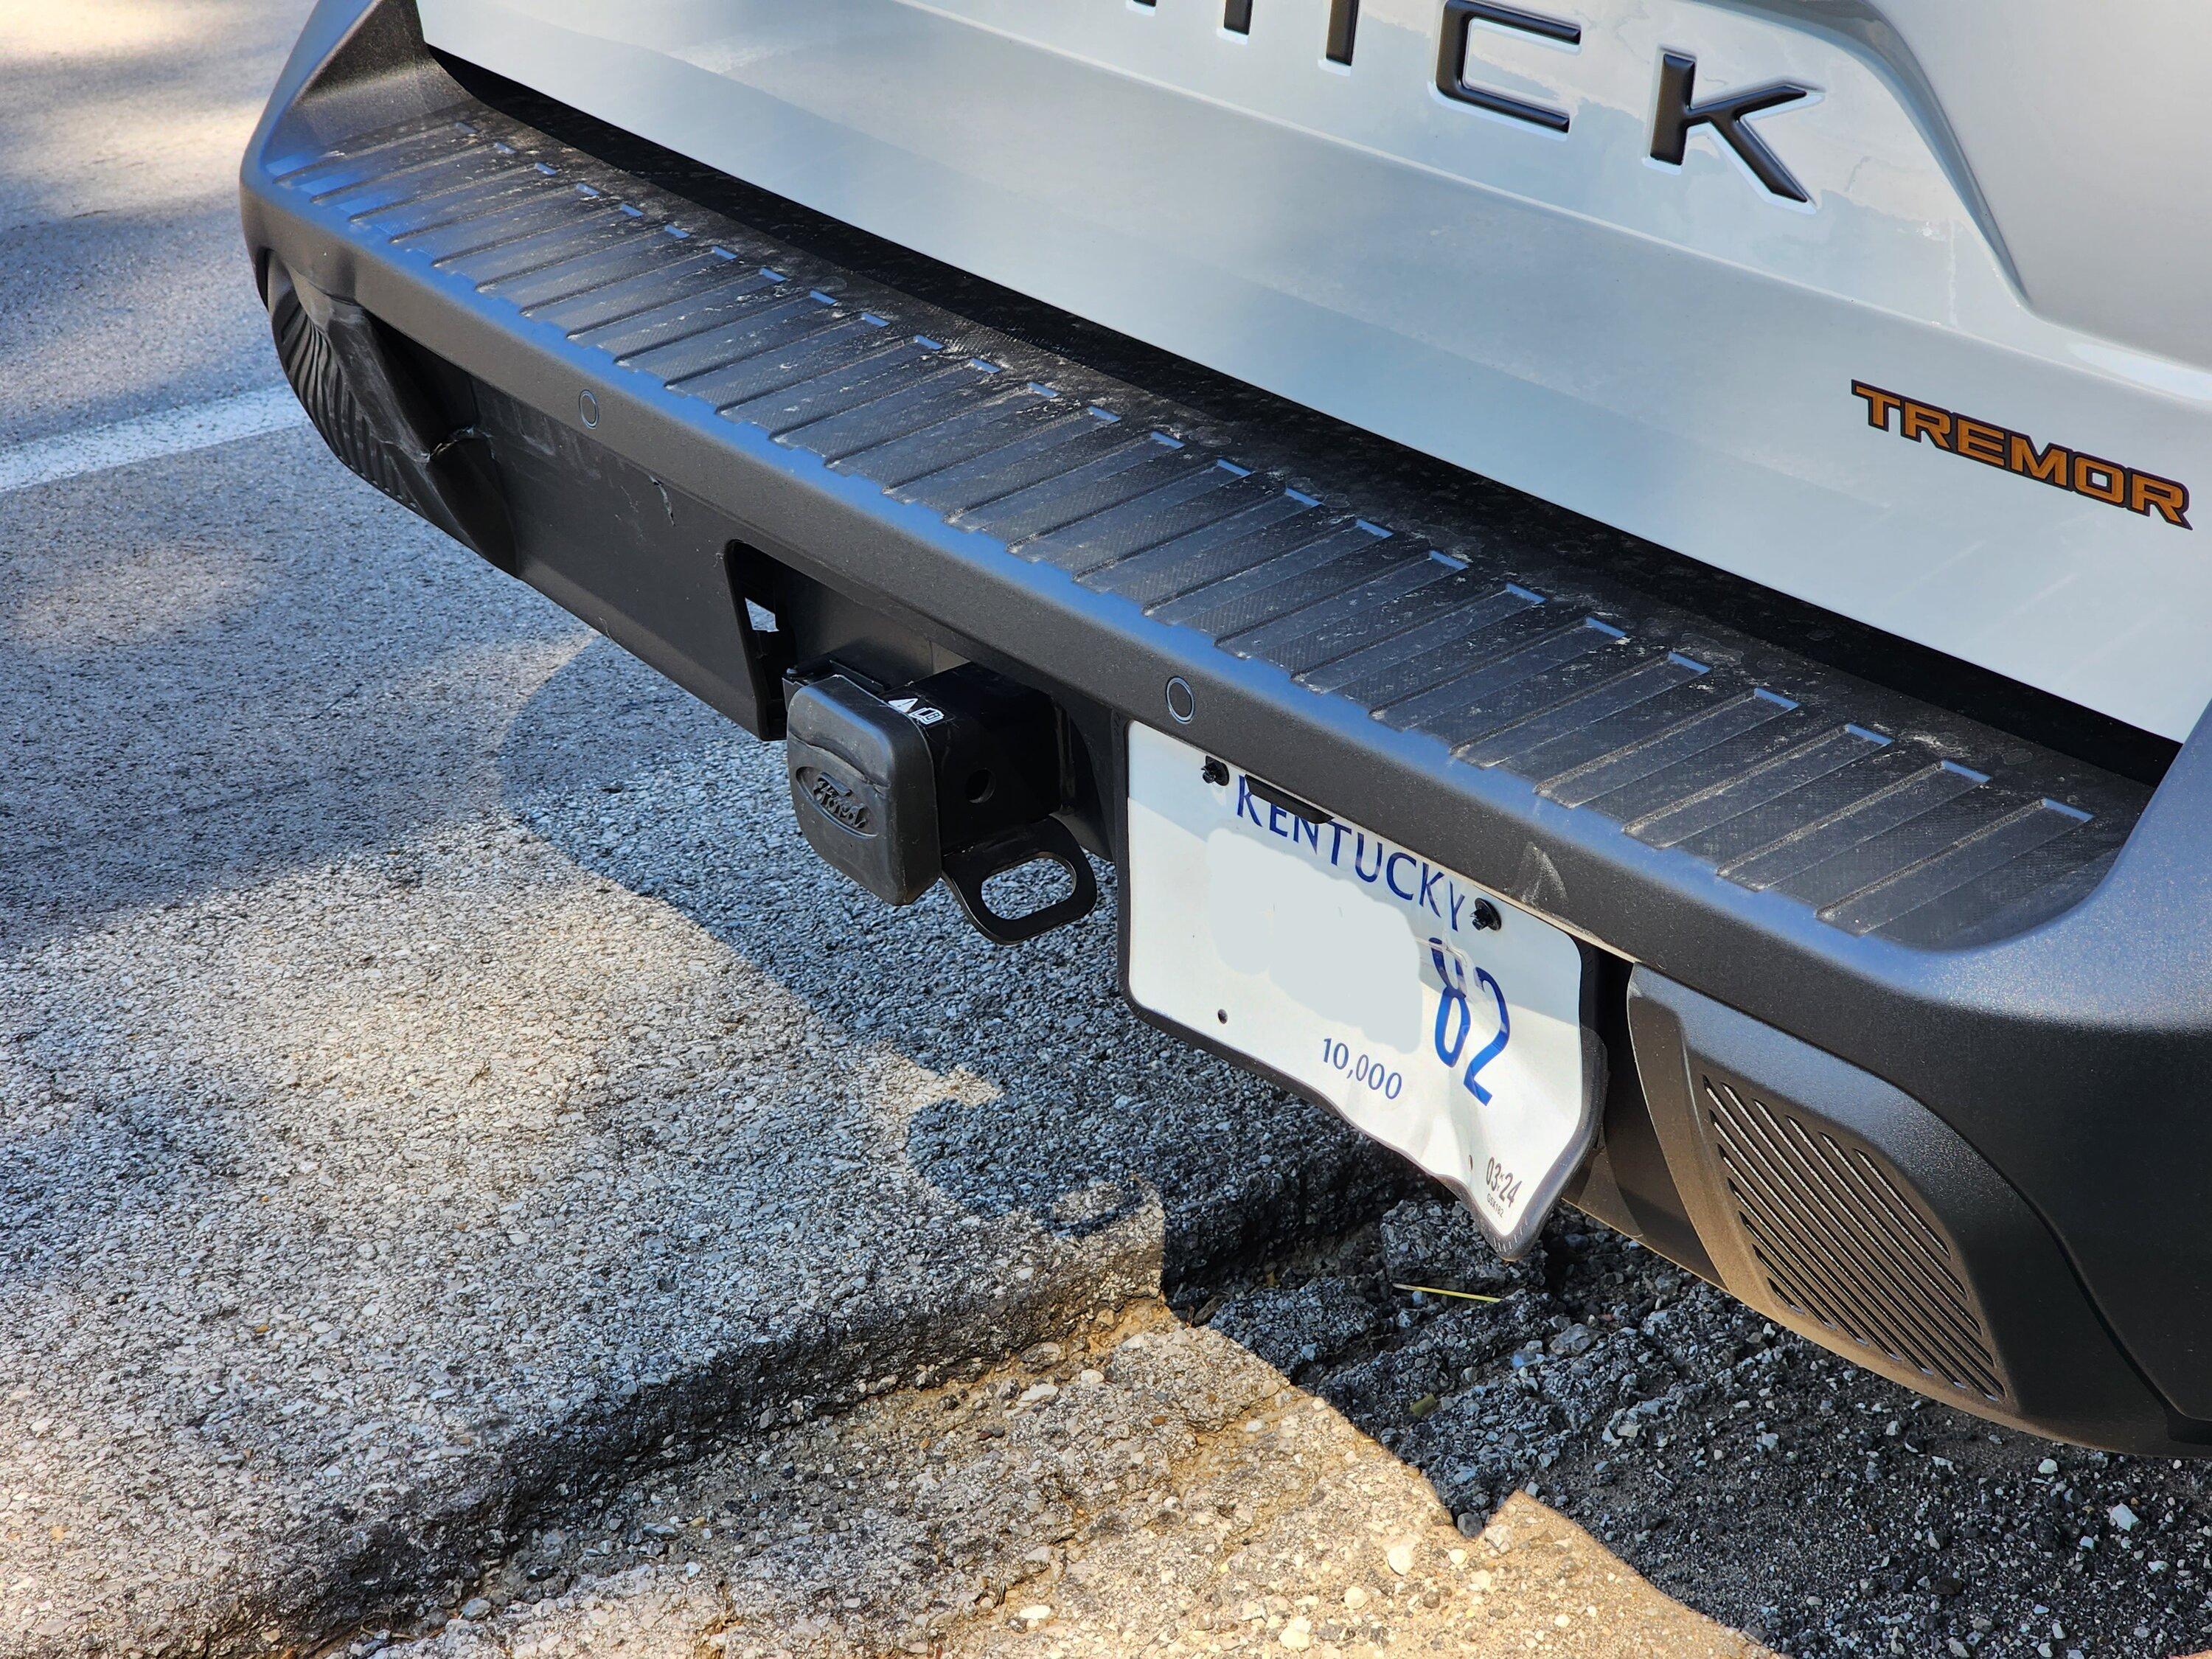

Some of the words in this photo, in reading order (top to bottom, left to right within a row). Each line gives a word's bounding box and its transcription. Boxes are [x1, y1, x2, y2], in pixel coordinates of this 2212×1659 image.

[1851, 379, 2193, 530] TREMOR
[1237, 775, 1466, 933] KENTUCKY
[1324, 1037, 1402, 1099] 10,000
